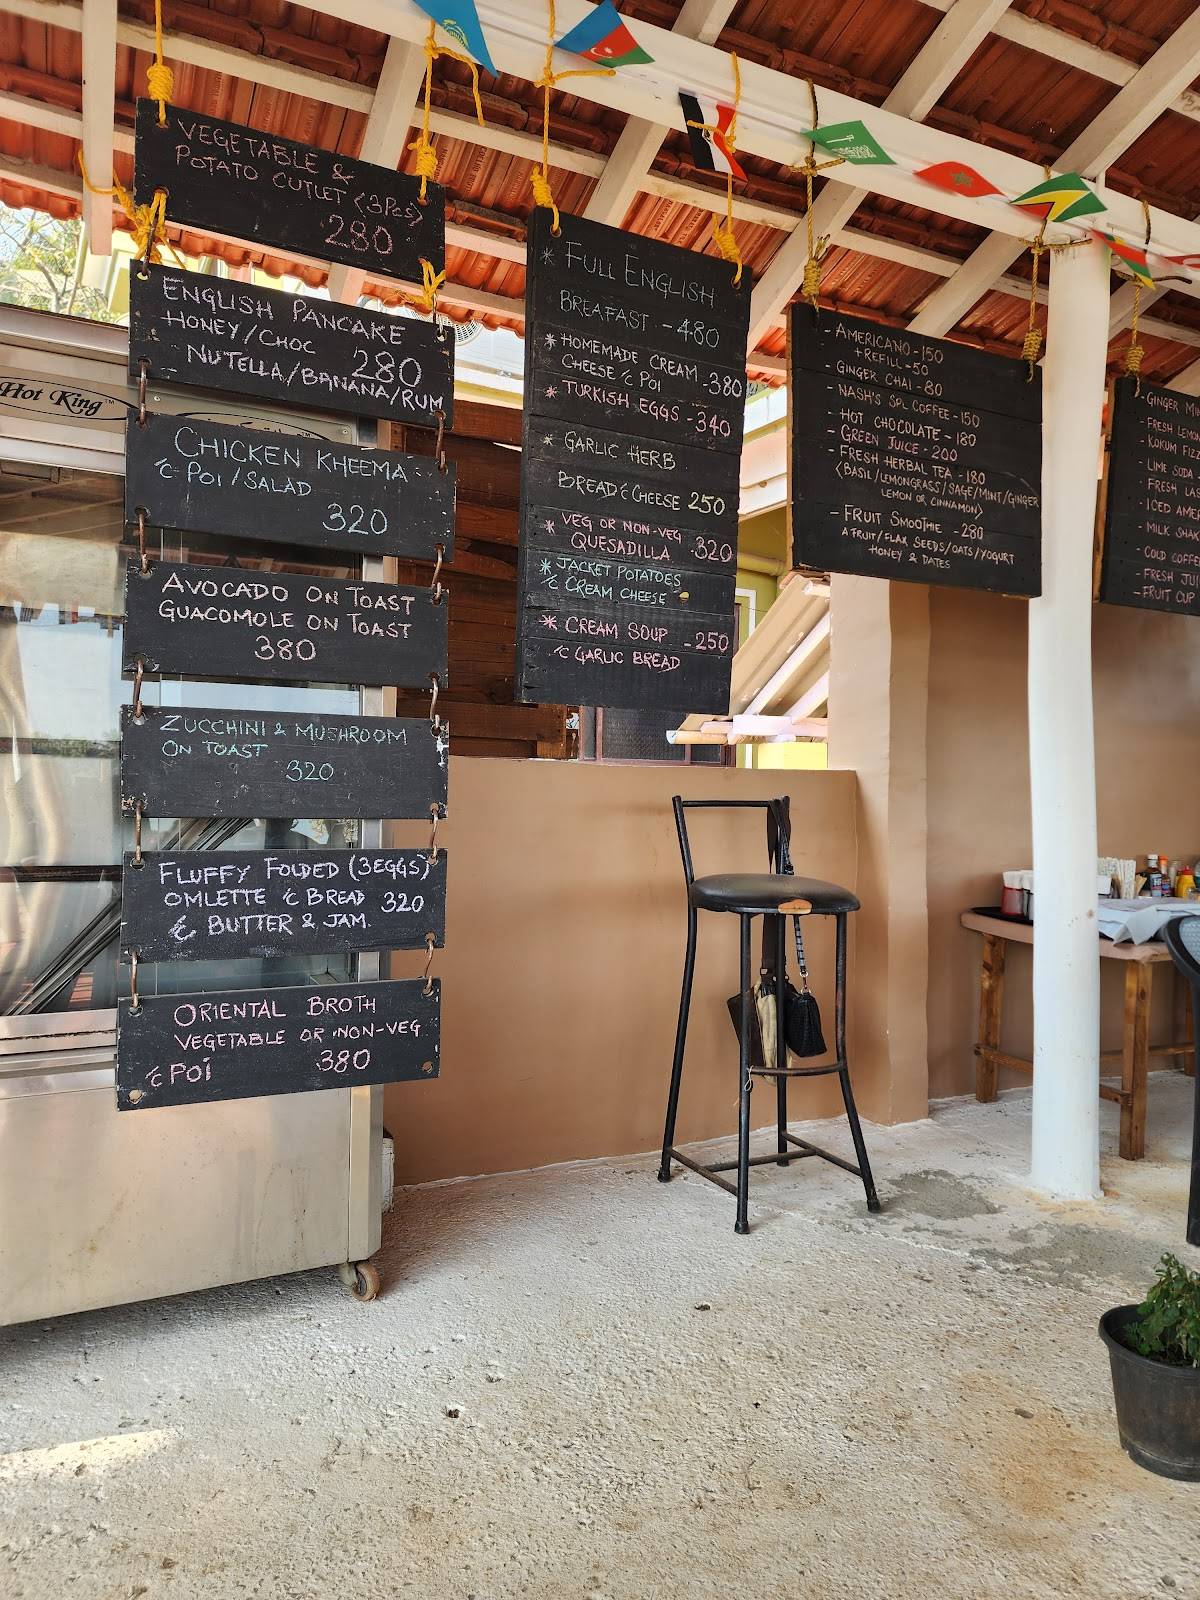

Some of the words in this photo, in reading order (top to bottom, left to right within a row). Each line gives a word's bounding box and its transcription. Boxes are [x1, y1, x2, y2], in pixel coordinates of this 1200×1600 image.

[178, 118, 319, 174] VEGETABLE
[332, 163, 354, 185] &
[176, 145, 258, 180] POTATO
[272, 172, 347, 204] CUTLET
[326, 214, 393, 255] 280
[565, 241, 616, 281] FULL
[625, 254, 715, 308] ENGLISH
[163, 275, 273, 320] ENGLISH
[293, 299, 405, 345] PANCAKE
[560, 289, 650, 332] BREAFAST
[835, 322, 911, 356] AMERICANO
[352, 349, 422, 388] 280
[560, 332, 638, 364] HOMEMADE
[649, 354, 698, 382] CREAM
[561, 353, 616, 381] CHEESE
[640, 371, 661, 392] POI
[836, 359, 878, 383] GINGER
[885, 373, 912, 391] CHAI
[0, 382, 43, 401] Hot
[49, 390, 103, 416] King
[561, 380, 630, 408] TURKISH
[639, 398, 680, 422] EGGS
[838, 383, 881, 406] NASH'S
[912, 400, 950, 421] COFFEE
[1146, 391, 1179, 414] GINGER
[839, 408, 864, 425] HOT
[874, 415, 941, 441] CHOCOLATE
[840, 423, 879, 446] GREEN
[887, 435, 920, 455] JUICE
[1147, 417, 1173, 433] FRESH
[174, 426, 300, 467] CHICKEN
[317, 449, 408, 482] KHEEMA
[564, 430, 618, 459] GARLIC
[627, 445, 676, 471] HERB
[840, 444, 879, 465] FRESH
[883, 455, 928, 475] HERBAL
[932, 465, 953, 479] TEA
[1148, 434, 1177, 455] KOKUM
[1183, 445, 1200, 460] FIZZ
[1147, 458, 1167, 473] LIME
[1172, 464, 1193, 479] SODA
[558, 470, 617, 500] BREAD
[632, 484, 681, 511] CHEESE
[688, 492, 726, 516] 250
[881, 488, 912, 501] LEMON
[916, 494, 928, 506] OR
[1148, 478, 1177, 496] FRESH
[322, 503, 388, 535] 320
[843, 504, 882, 525] FRUIT
[890, 510, 943, 533] SMOOTHIE
[1146, 498, 1171, 513] ICED
[562, 512, 593, 532] VEG
[600, 519, 616, 530] OR
[1146, 521, 1170, 536] MILK
[571, 532, 670, 561] QUESADILLA
[868, 544, 902, 563] HONEY
[909, 552, 918, 562] &
[922, 554, 950, 570] DATES
[1144, 545, 1167, 560] COLD
[556, 557, 612, 577] JACKET
[617, 566, 682, 588] POTATOES
[1144, 568, 1173, 583] FRESH
[161, 572, 289, 602] AVOCADO
[345, 586, 416, 616] TOAST
[565, 576, 613, 600] CREAM
[620, 588, 667, 605] CHEESE
[1143, 585, 1172, 602] FRUIT
[1176, 590, 1196, 604] CUP
[159, 599, 295, 629] GUACOMOLE
[307, 615, 339, 632] ON
[347, 613, 413, 639] TOAST
[565, 616, 618, 640] CREAM
[628, 622, 668, 643] SOUP
[254, 636, 316, 661] 380
[574, 646, 624, 665] GARLIC
[633, 651, 681, 673] BREAD
[160, 715, 266, 737] ZUCCHINI
[274, 722, 287, 737] &
[295, 723, 408, 746] MUSHROOM
[202, 741, 269, 759] TOAST
[286, 760, 334, 782] 320
[159, 862, 251, 886] FLUFFY
[264, 857, 340, 881] FOLDED
[349, 854, 431, 881] (3EGGS)
[164, 888, 266, 908] OMLETTE
[307, 887, 365, 907] BREAD
[381, 892, 424, 913] 320
[208, 914, 294, 937] BUTTER
[302, 914, 315, 929] &
[174, 999, 287, 1028] ORIENTAL
[306, 995, 376, 1016] BROTH
[174, 1029, 286, 1052] VEGETABLE
[299, 1027, 324, 1043] OR
[316, 1048, 371, 1074] 380
